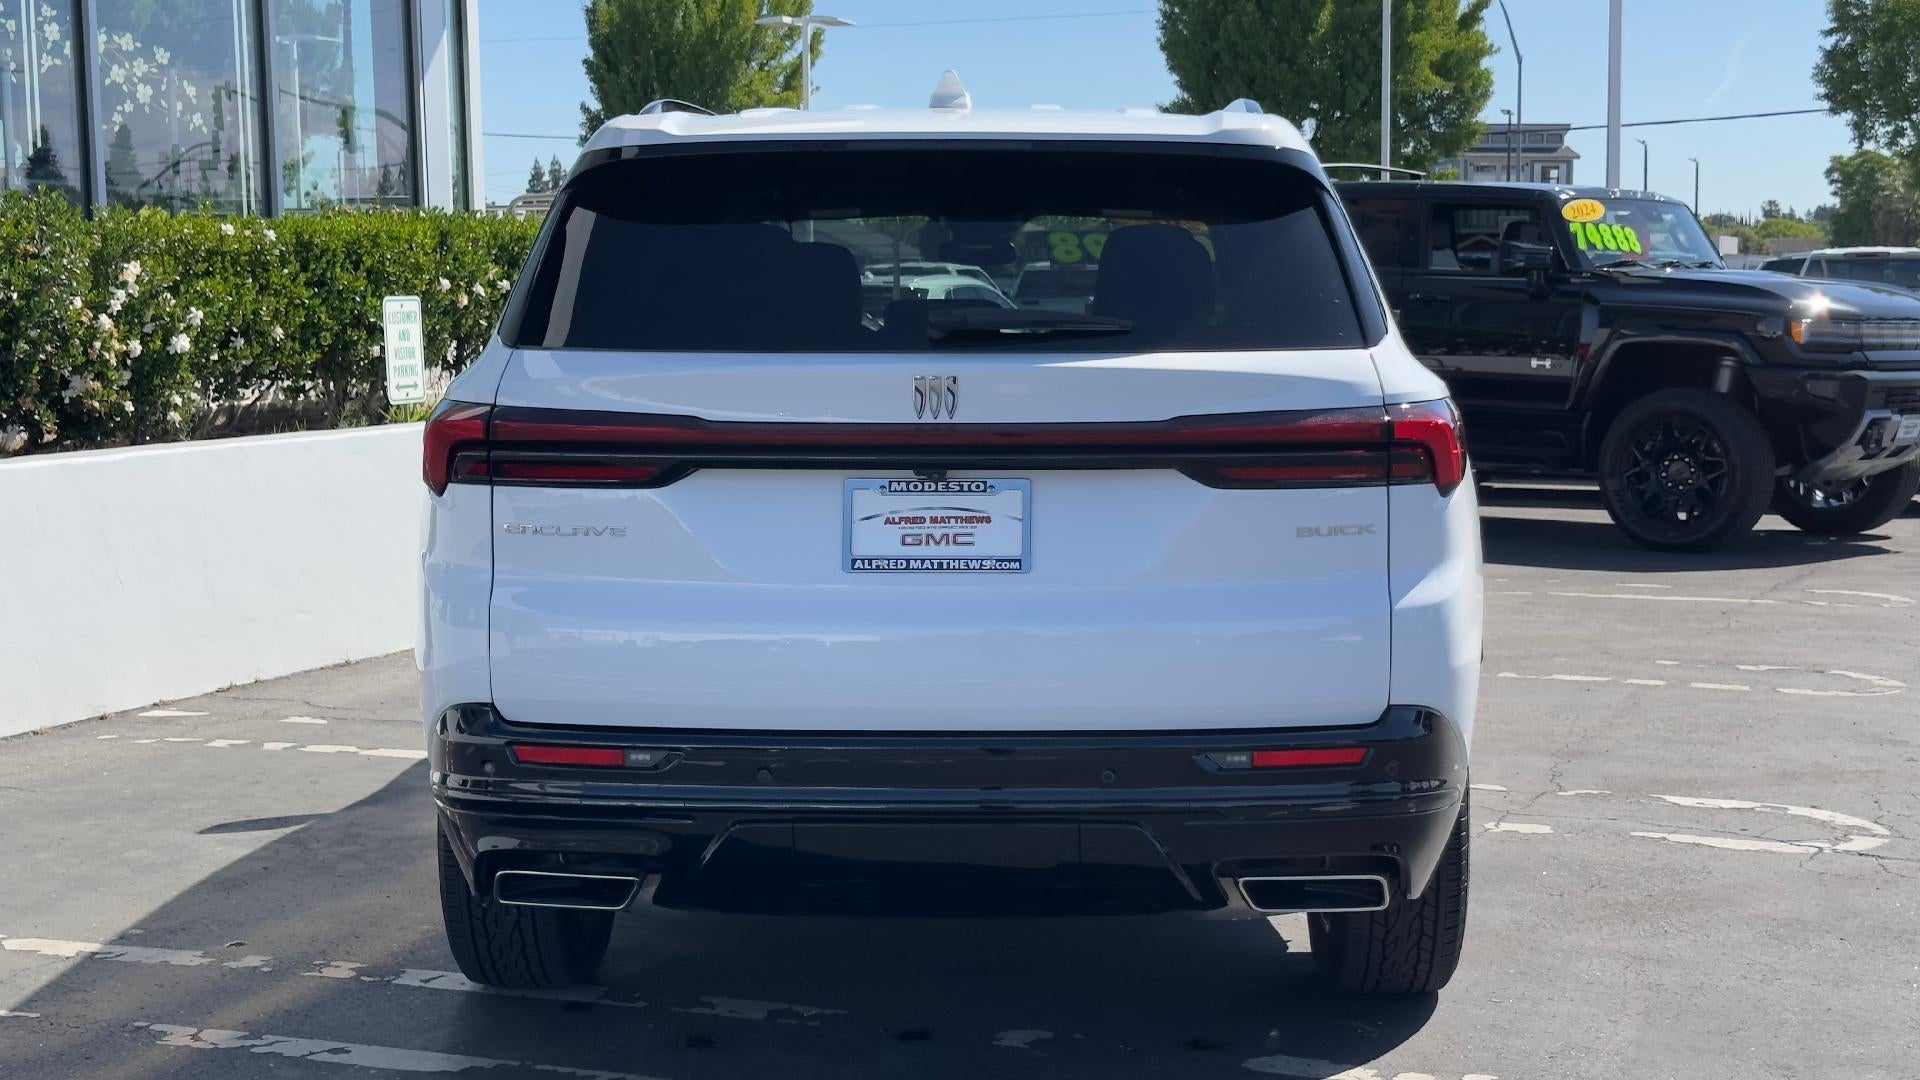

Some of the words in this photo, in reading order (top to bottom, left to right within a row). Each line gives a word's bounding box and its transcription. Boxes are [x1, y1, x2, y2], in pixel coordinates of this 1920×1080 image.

[1570, 203, 1596, 219] 2024
[388, 311, 418, 325] CUSTOMER
[398, 329, 411, 342] AND
[394, 346, 416, 361] VISITOR
[393, 364, 418, 379] PARKING
[890, 481, 985, 492] MODESTO
[884, 516, 926, 525] ALFRED
[929, 516, 991, 524] MATTHEWS
[504, 524, 626, 537] ENCLAVE
[1296, 523, 1376, 538] BUICK
[901, 532, 975, 546] GMC
[854, 559, 906, 569] ALFRED
